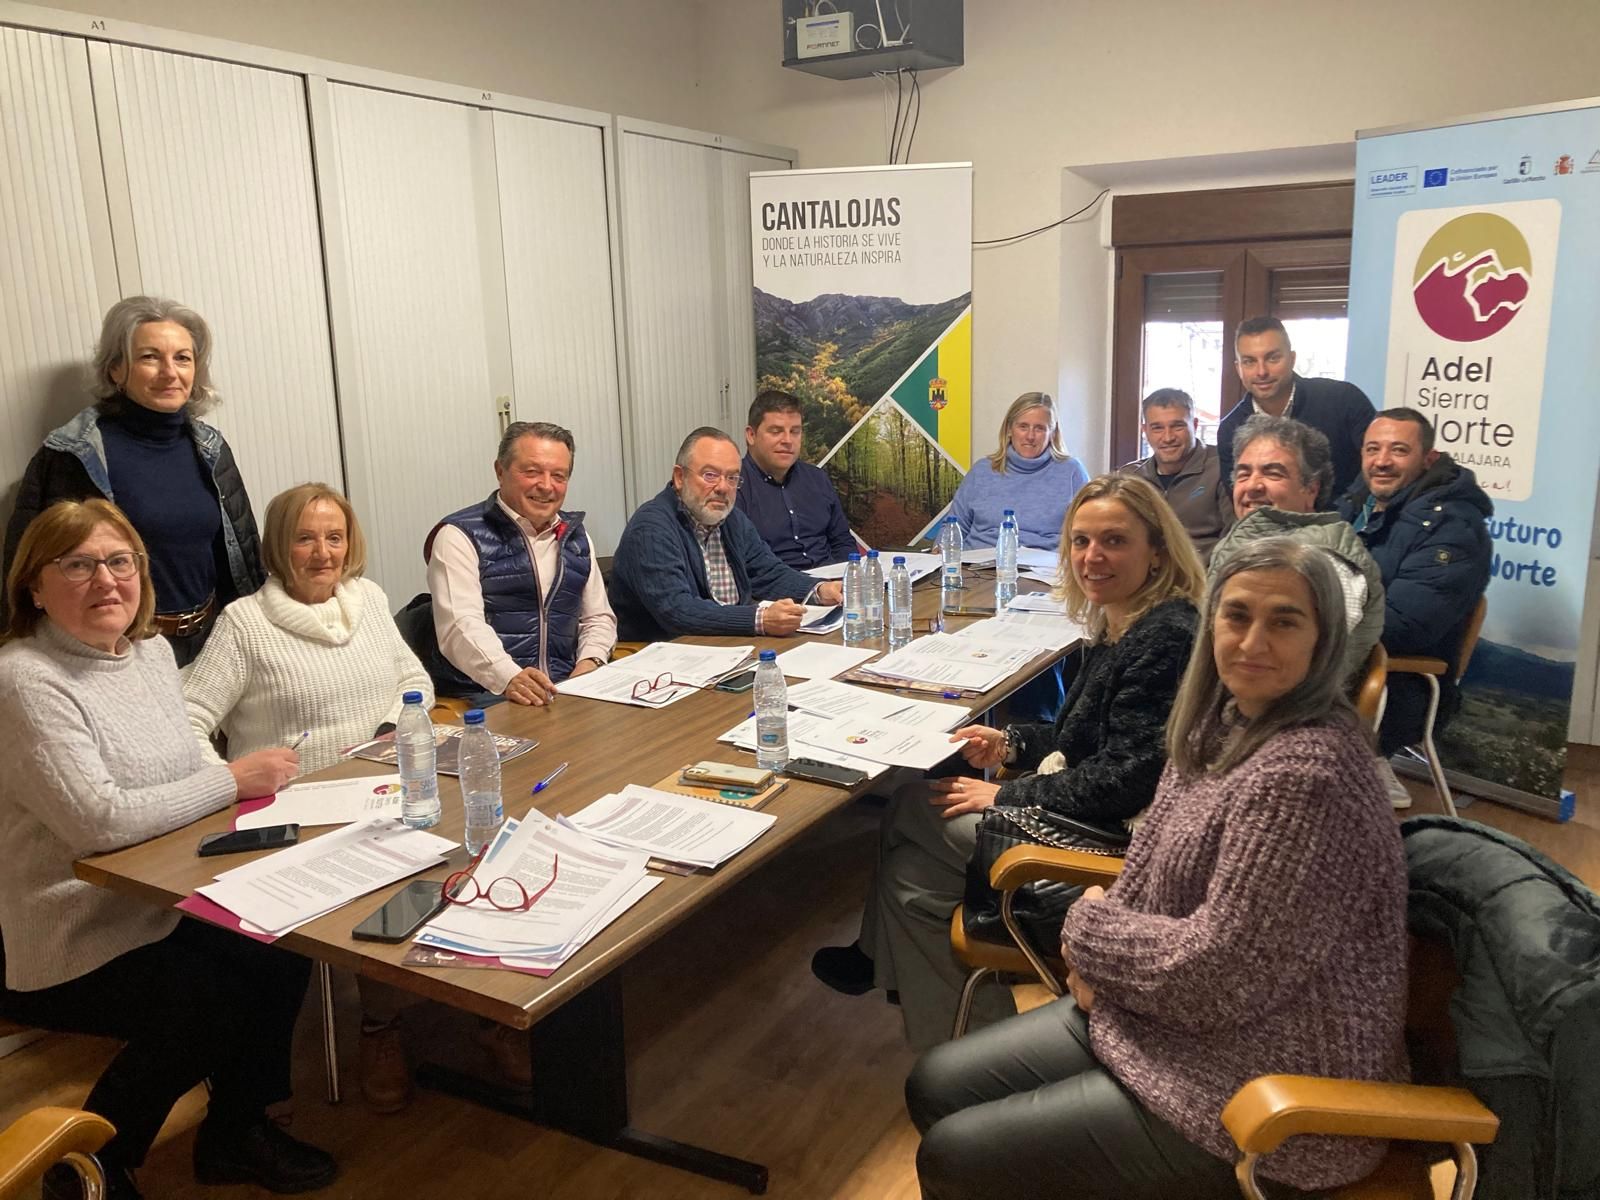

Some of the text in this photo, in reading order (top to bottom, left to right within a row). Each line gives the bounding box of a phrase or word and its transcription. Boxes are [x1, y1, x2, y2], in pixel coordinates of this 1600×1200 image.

[1371, 172, 1408, 184] LEADER
[762, 197, 901, 231] CANTALOJAS
[762, 232, 902, 250] DONDE LA HISTORIA SE VIVE
[763, 250, 902, 267] Y LA NATURALEZA INSPIRA
[1421, 355, 1493, 382] Adel
[1417, 387, 1489, 410] Sierra
[1453, 452, 1511, 469] ALAJARA
